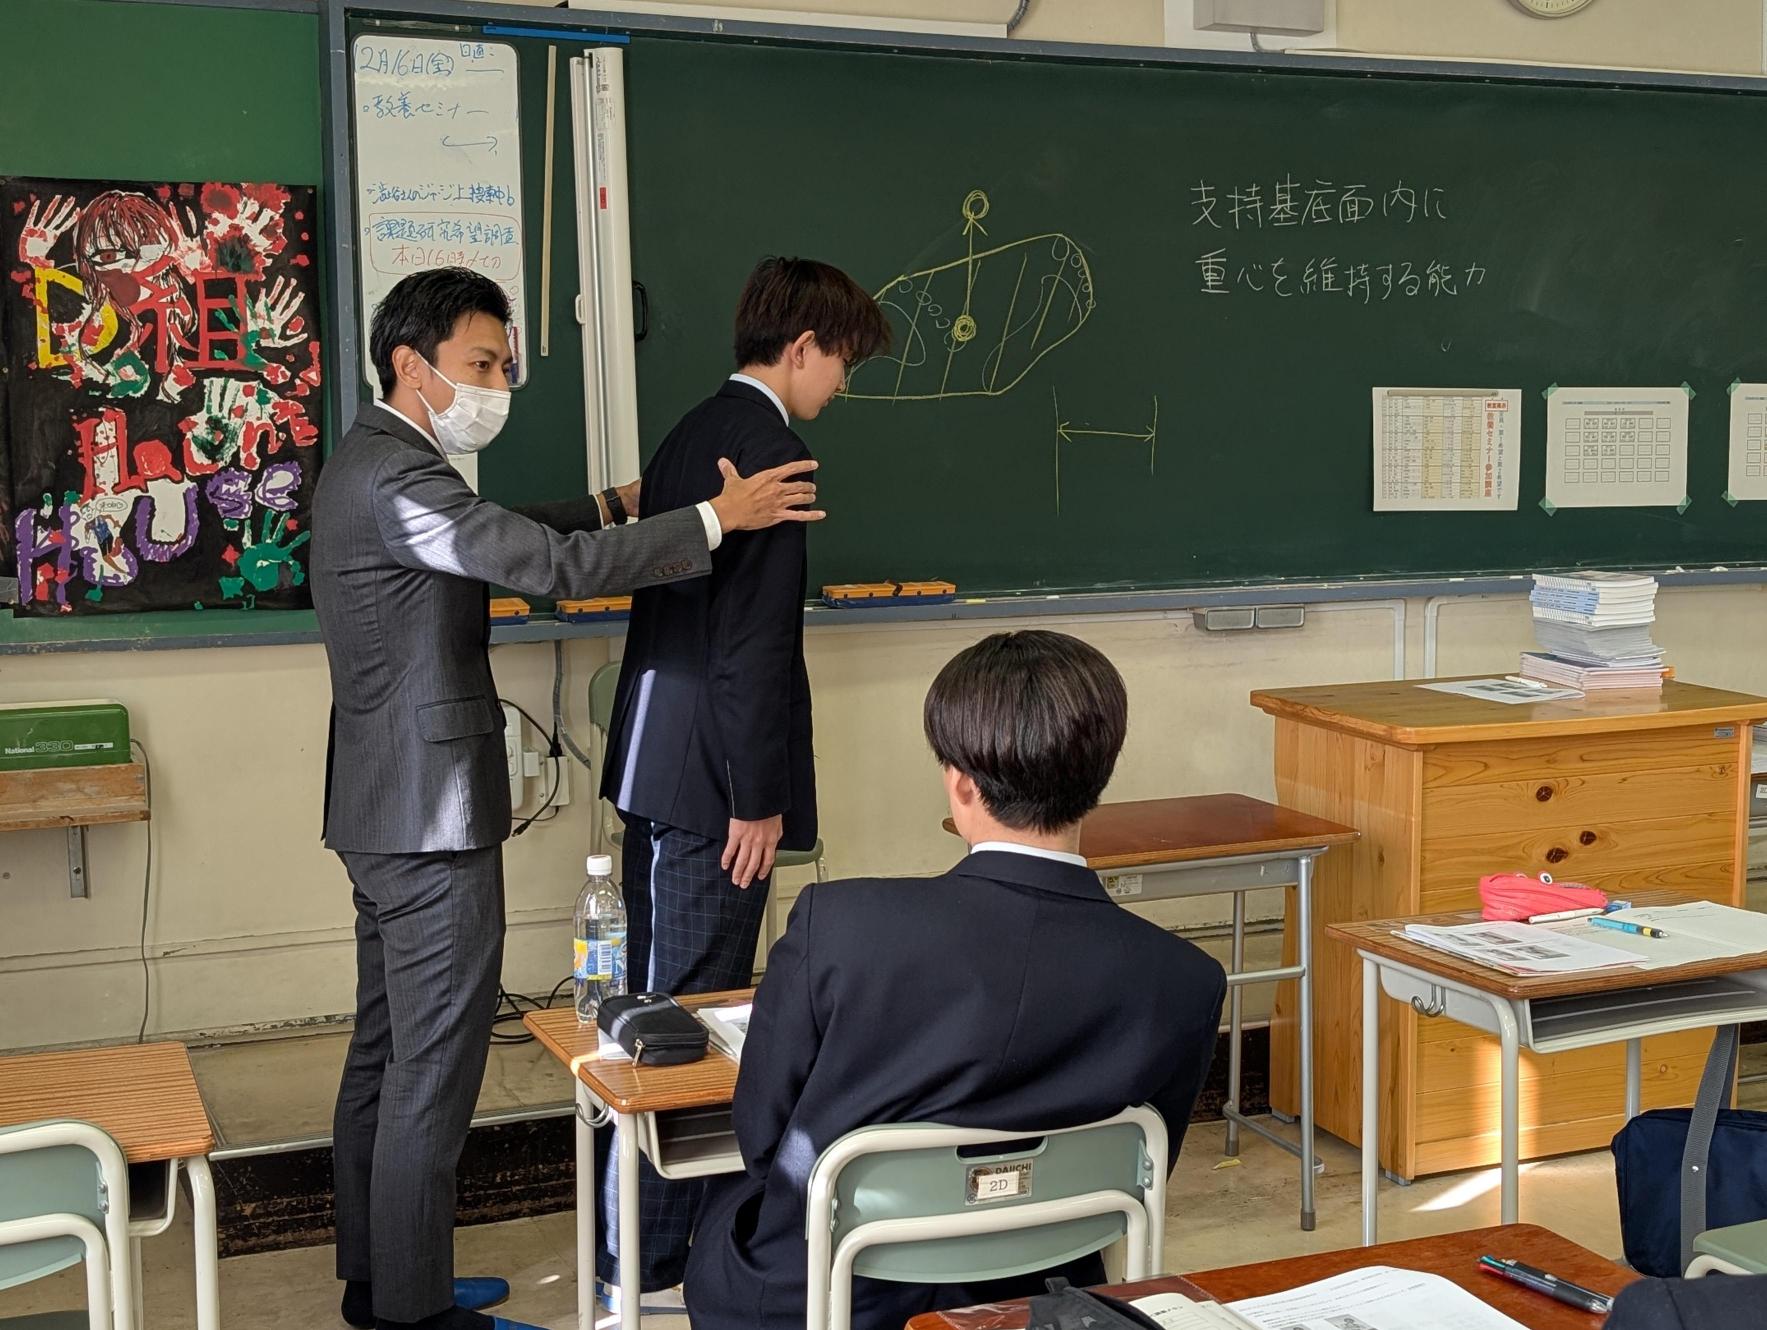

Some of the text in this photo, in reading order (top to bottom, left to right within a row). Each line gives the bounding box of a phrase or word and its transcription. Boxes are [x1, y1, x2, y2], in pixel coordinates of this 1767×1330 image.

[360, 46, 455, 76] 2月16日(金)
[372, 91, 489, 119] 教養セミナー
[1190, 172, 1447, 229] 支持基底面内に
[371, 215, 520, 246] 課題研究希望調査
[1194, 248, 1487, 304] 重心を維持する能力
[5, 746, 35, 754] National
[35, 740, 74, 753] 330
[989, 1179, 1009, 1192] 2D
